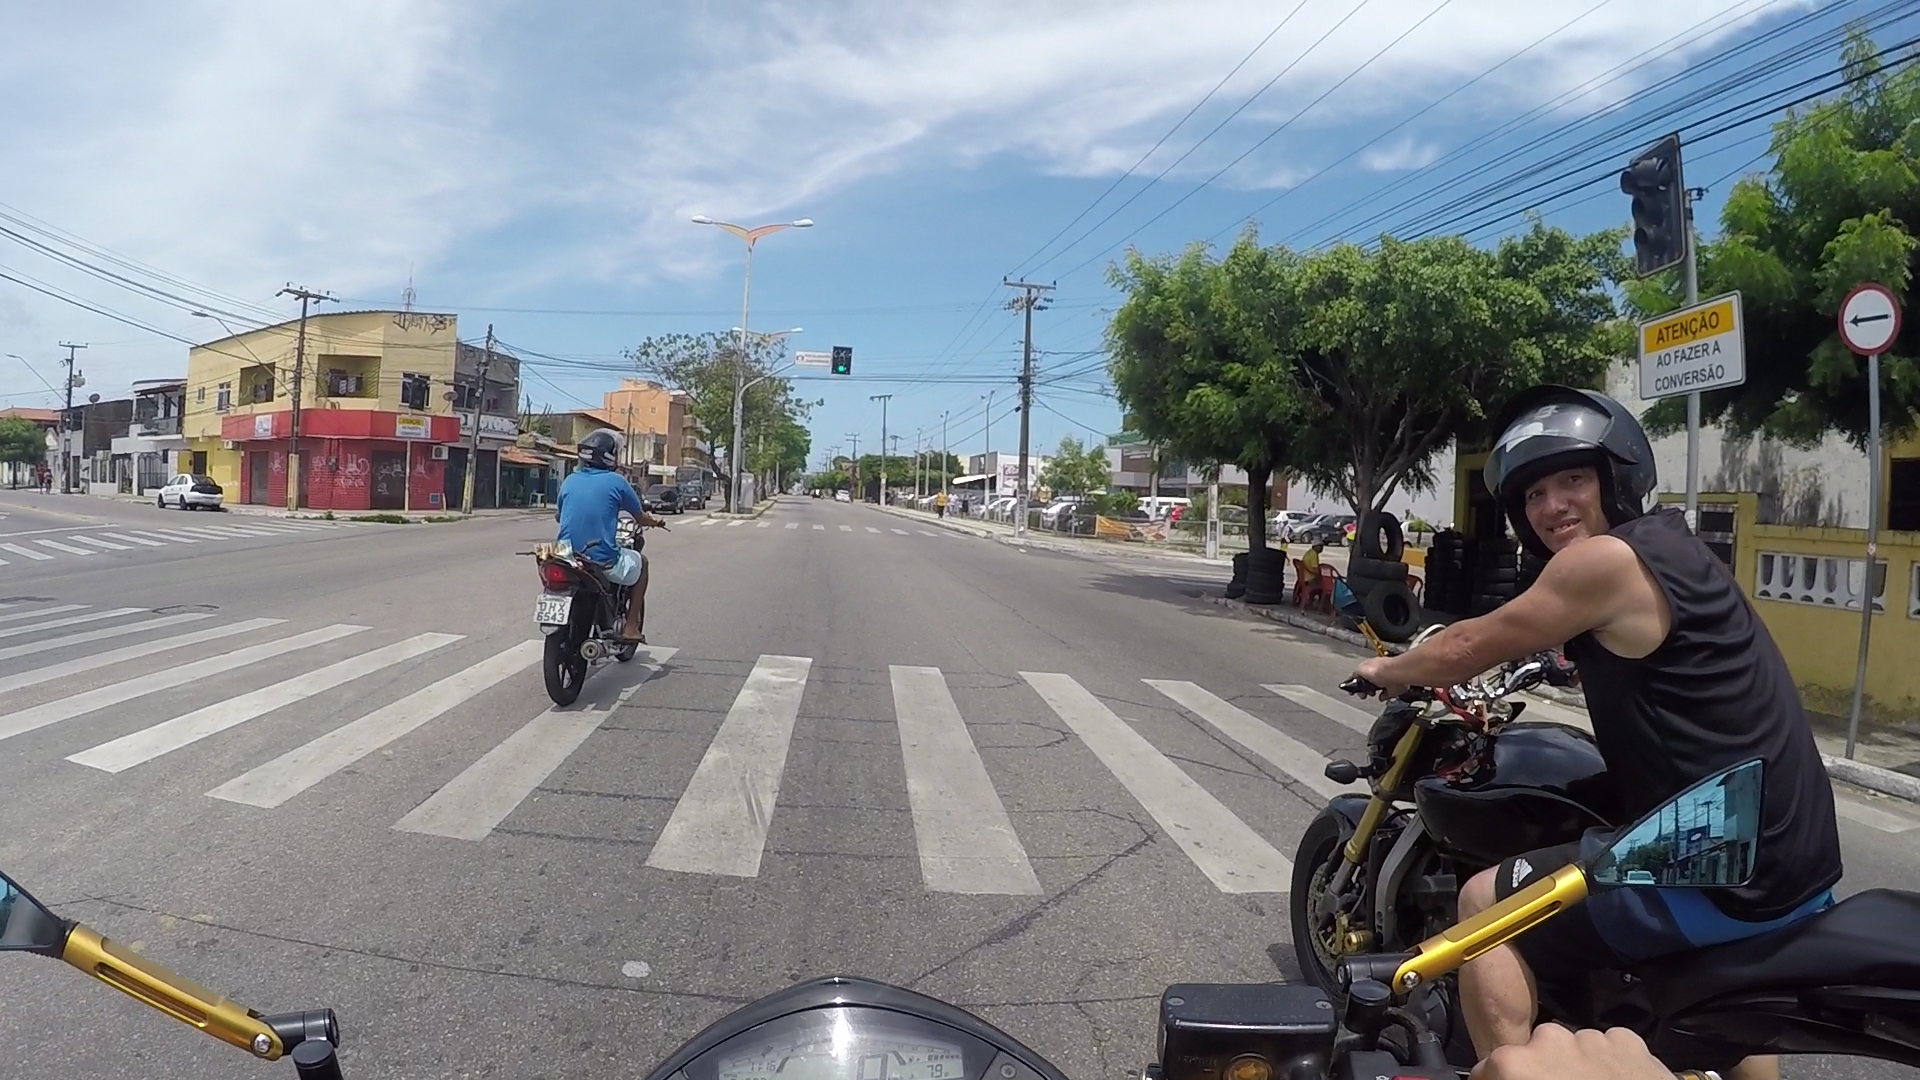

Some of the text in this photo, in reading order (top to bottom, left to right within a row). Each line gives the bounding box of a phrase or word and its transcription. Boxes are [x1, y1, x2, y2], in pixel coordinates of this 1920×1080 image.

[1656, 311, 1719, 345] ATENÇÃO
[1656, 340, 1721, 368] AO FAZER A
[1655, 364, 1725, 391] CONVERSÃO
[536, 611, 565, 623] 6543
